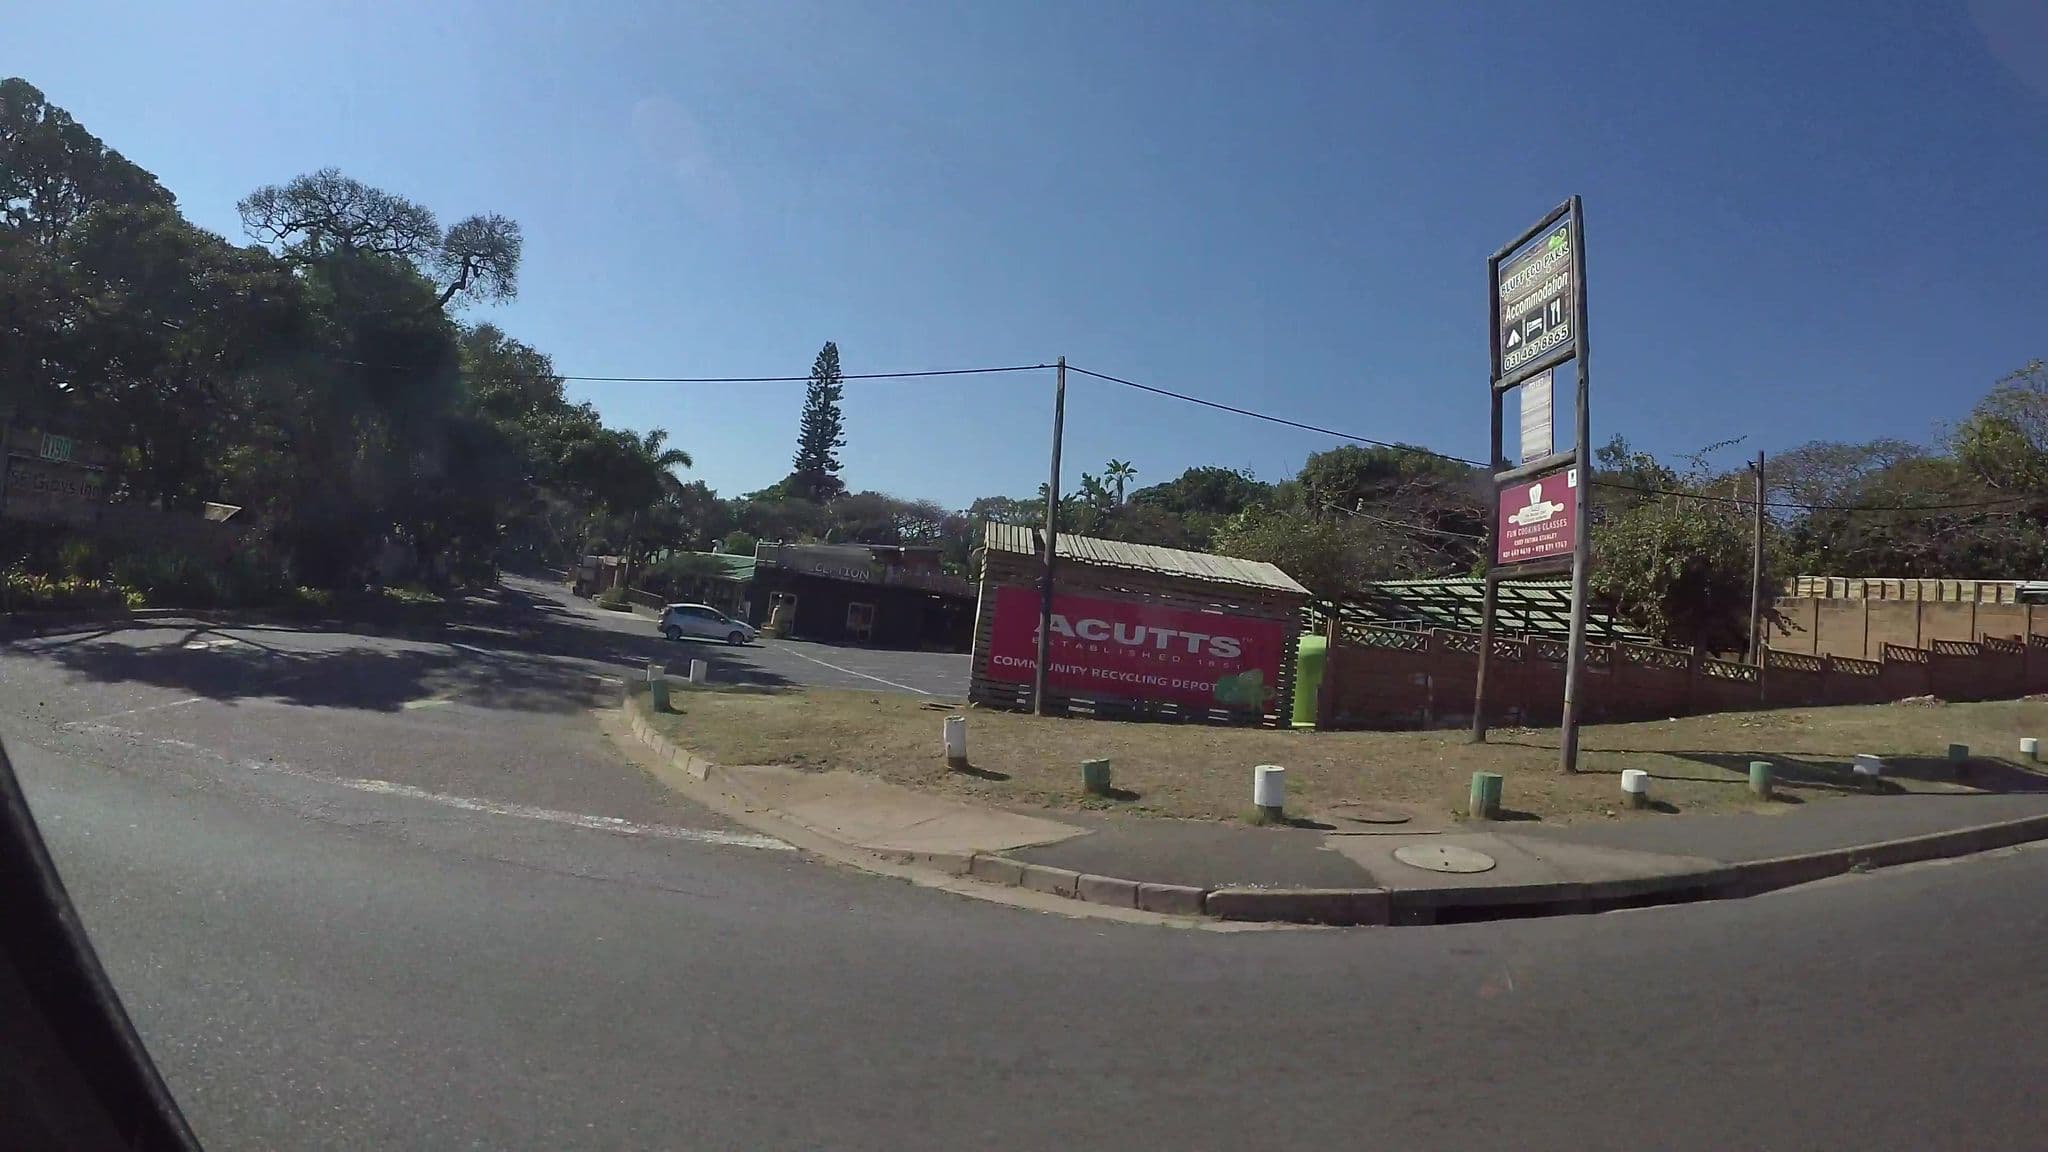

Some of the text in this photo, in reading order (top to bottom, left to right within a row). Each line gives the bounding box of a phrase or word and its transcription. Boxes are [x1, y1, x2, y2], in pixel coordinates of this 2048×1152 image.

[1500, 241, 1569, 297] BLUFF ECO PARK
[1505, 271, 1568, 323] Accommodation
[1504, 327, 1568, 371] 031 467 8865
[1506, 530, 1517, 539] FUN
[1518, 522, 1541, 536] COOKING
[1542, 518, 1567, 531] CLASSES
[1032, 637, 1181, 663] ESTABLISHED
[1034, 613, 1241, 658] ACUTTS
[1091, 668, 1168, 686] RECYCLING
[1172, 678, 1218, 692] DEPOT
